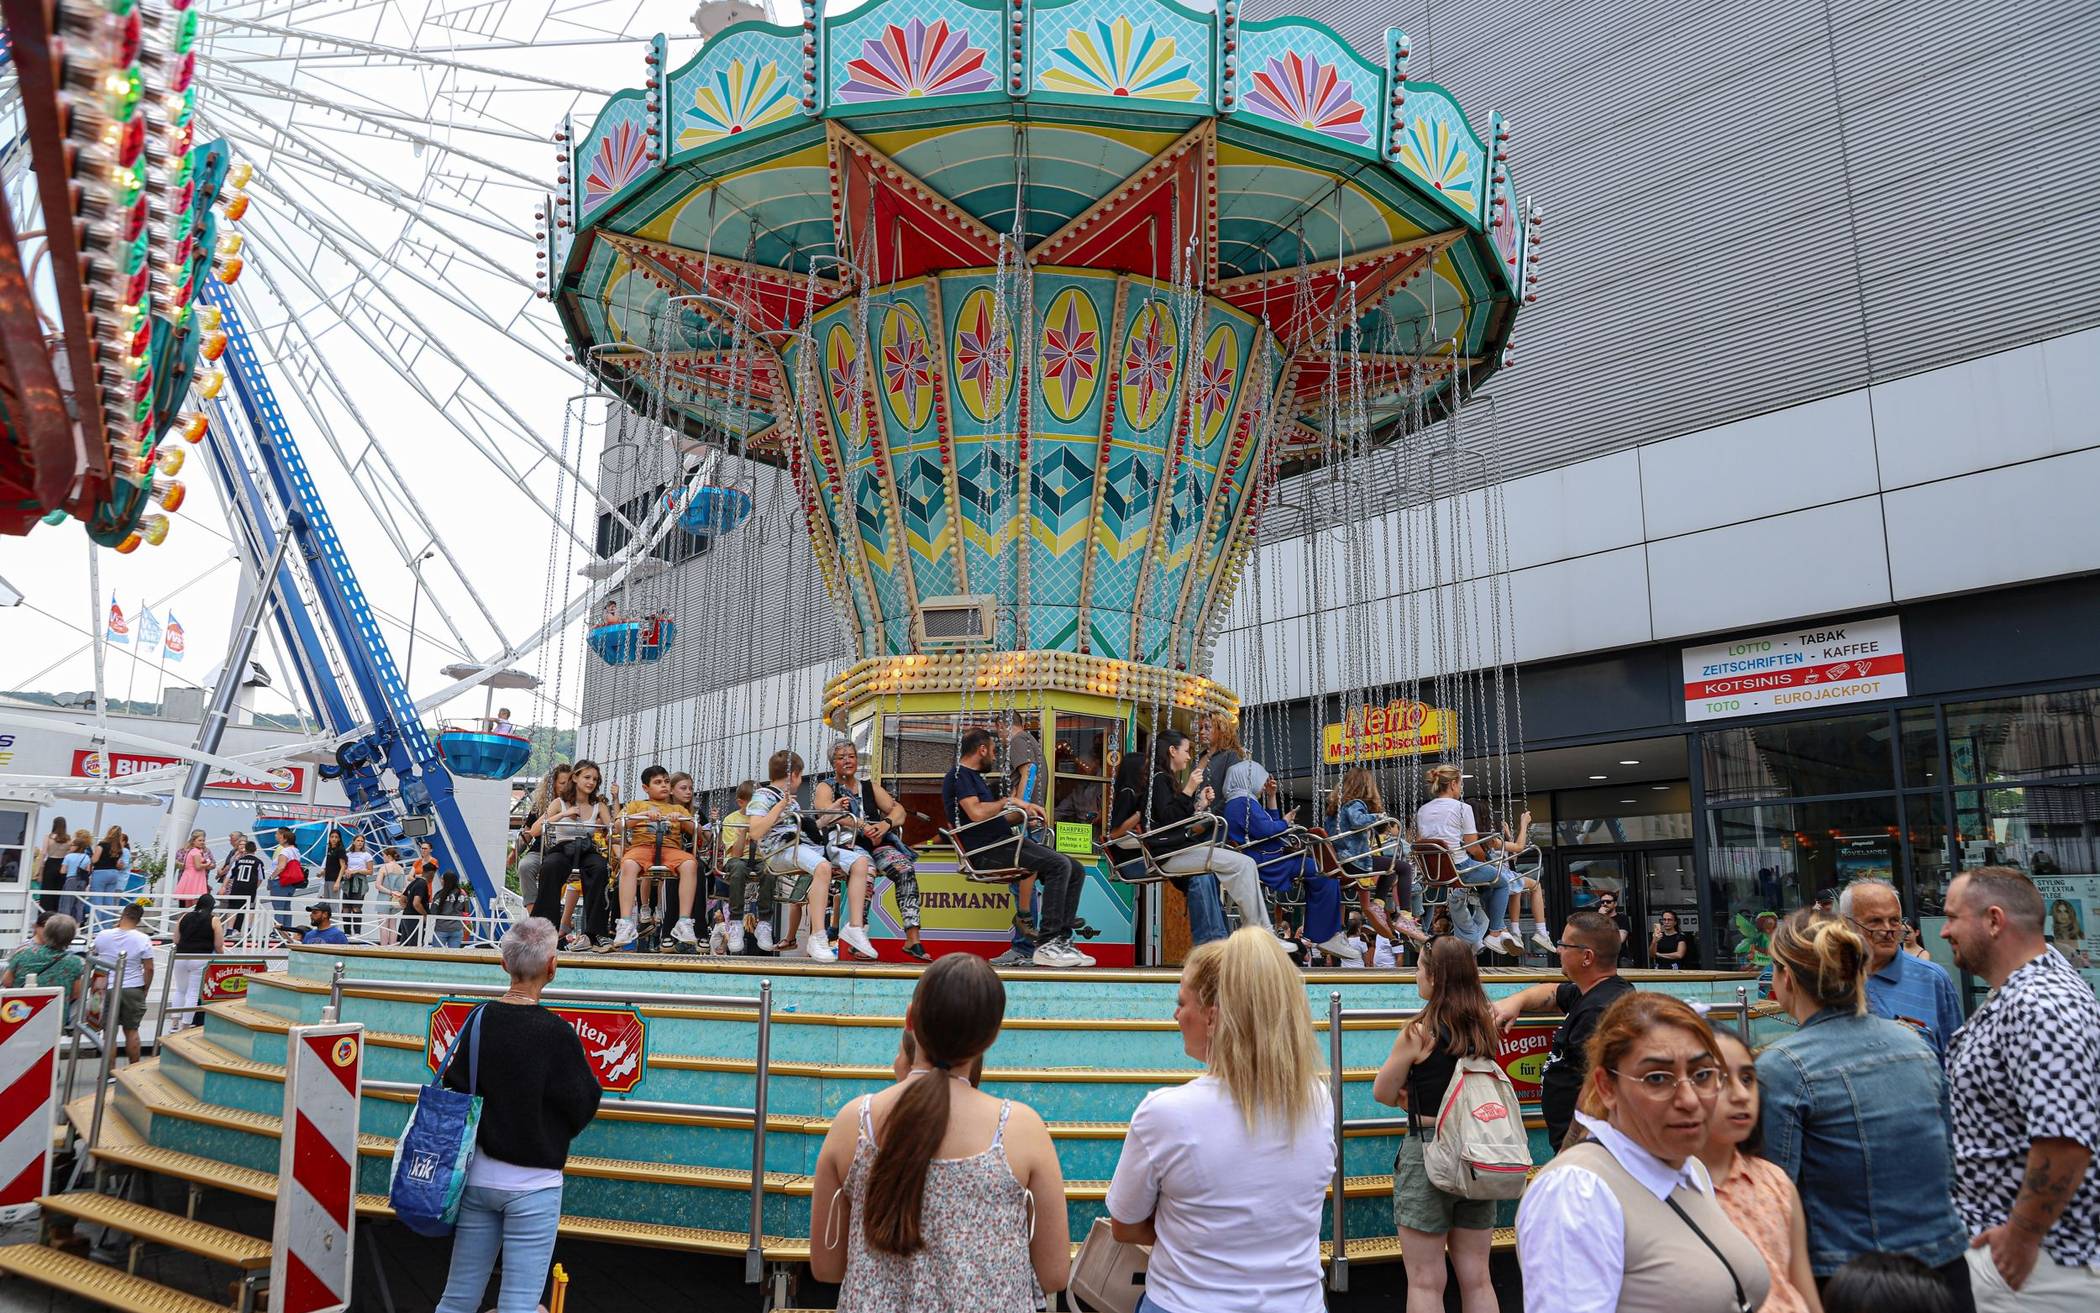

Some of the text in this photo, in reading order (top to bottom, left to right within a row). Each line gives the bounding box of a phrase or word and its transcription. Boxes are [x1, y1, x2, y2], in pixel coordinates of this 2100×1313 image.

[1728, 640, 1772, 657] LOTTO
[1799, 629, 1846, 646] TABAK
[1702, 652, 1803, 676] ZEITSCHRIFTEN
[1823, 640, 1879, 659] KAFFEE
[1705, 674, 1792, 694] KOTSINIS
[1706, 700, 1740, 713] TOTO
[1774, 682, 1881, 705] EUROJACKPOT
[1345, 699, 1428, 738] Netto
[237, 864, 252, 882] 10
[568, 1018, 608, 1047] lten
[1498, 1035, 1547, 1056] liegen
[1520, 1062, 1535, 1075] für
